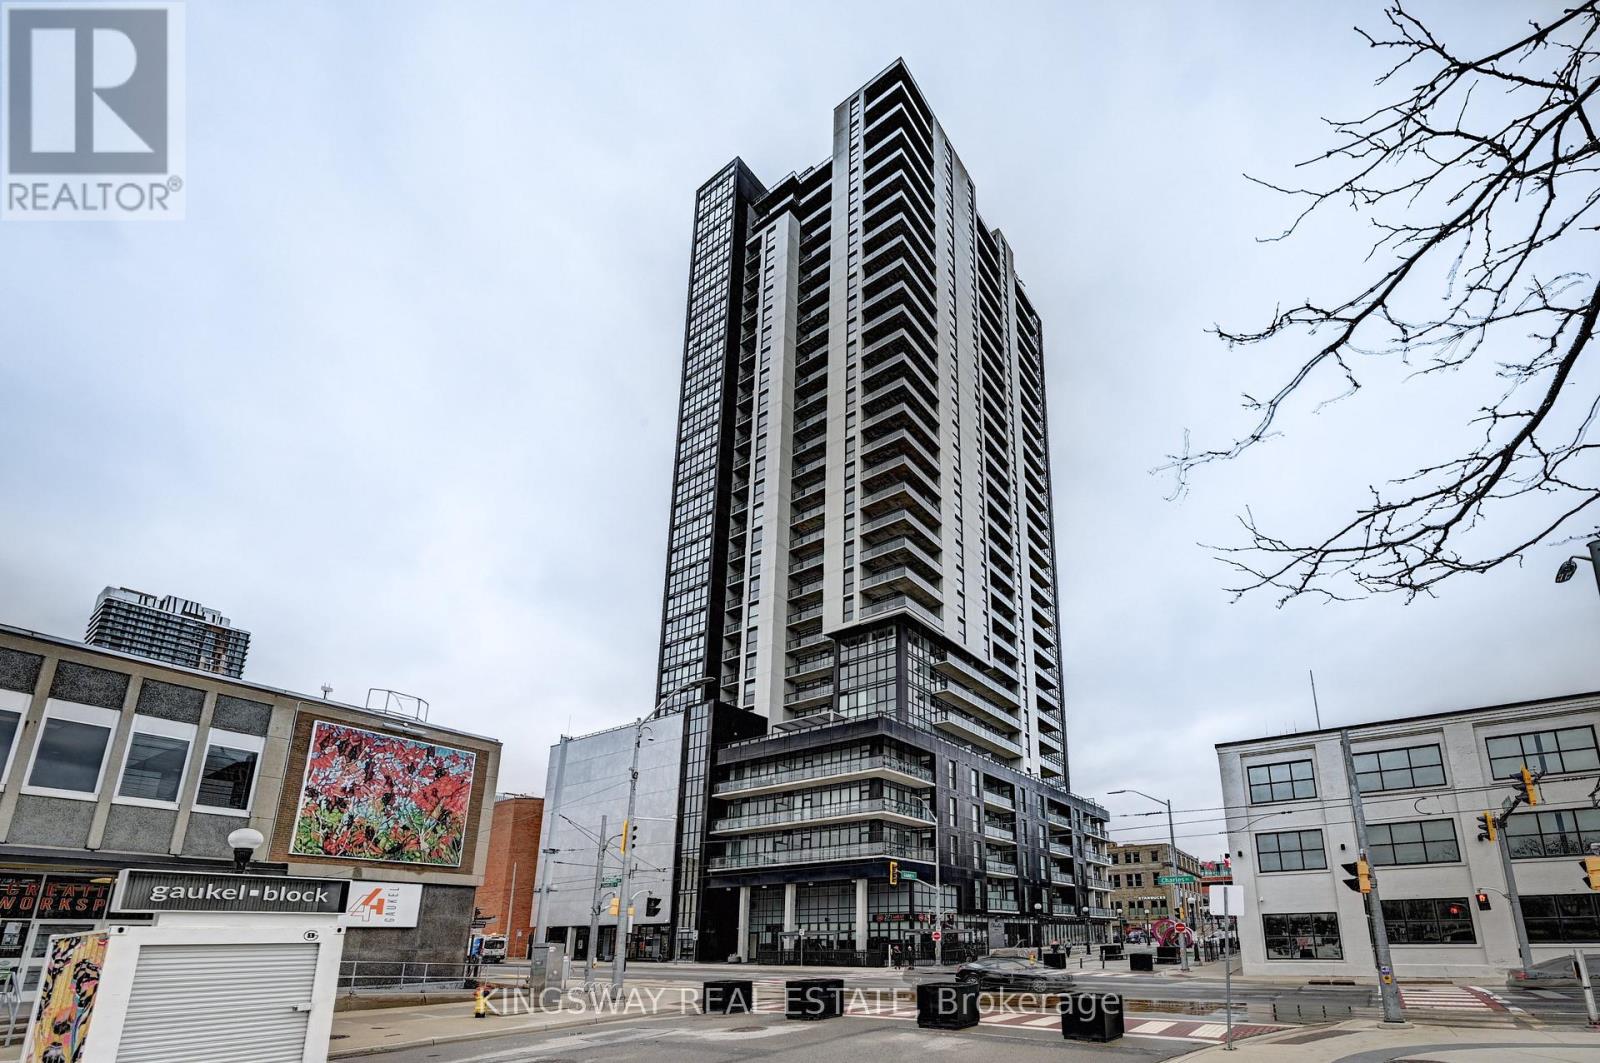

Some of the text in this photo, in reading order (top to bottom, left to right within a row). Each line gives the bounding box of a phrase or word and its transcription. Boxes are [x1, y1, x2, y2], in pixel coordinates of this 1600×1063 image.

[150, 884, 329, 903] gaukel block
[384, 887, 400, 923] GAUKEL
